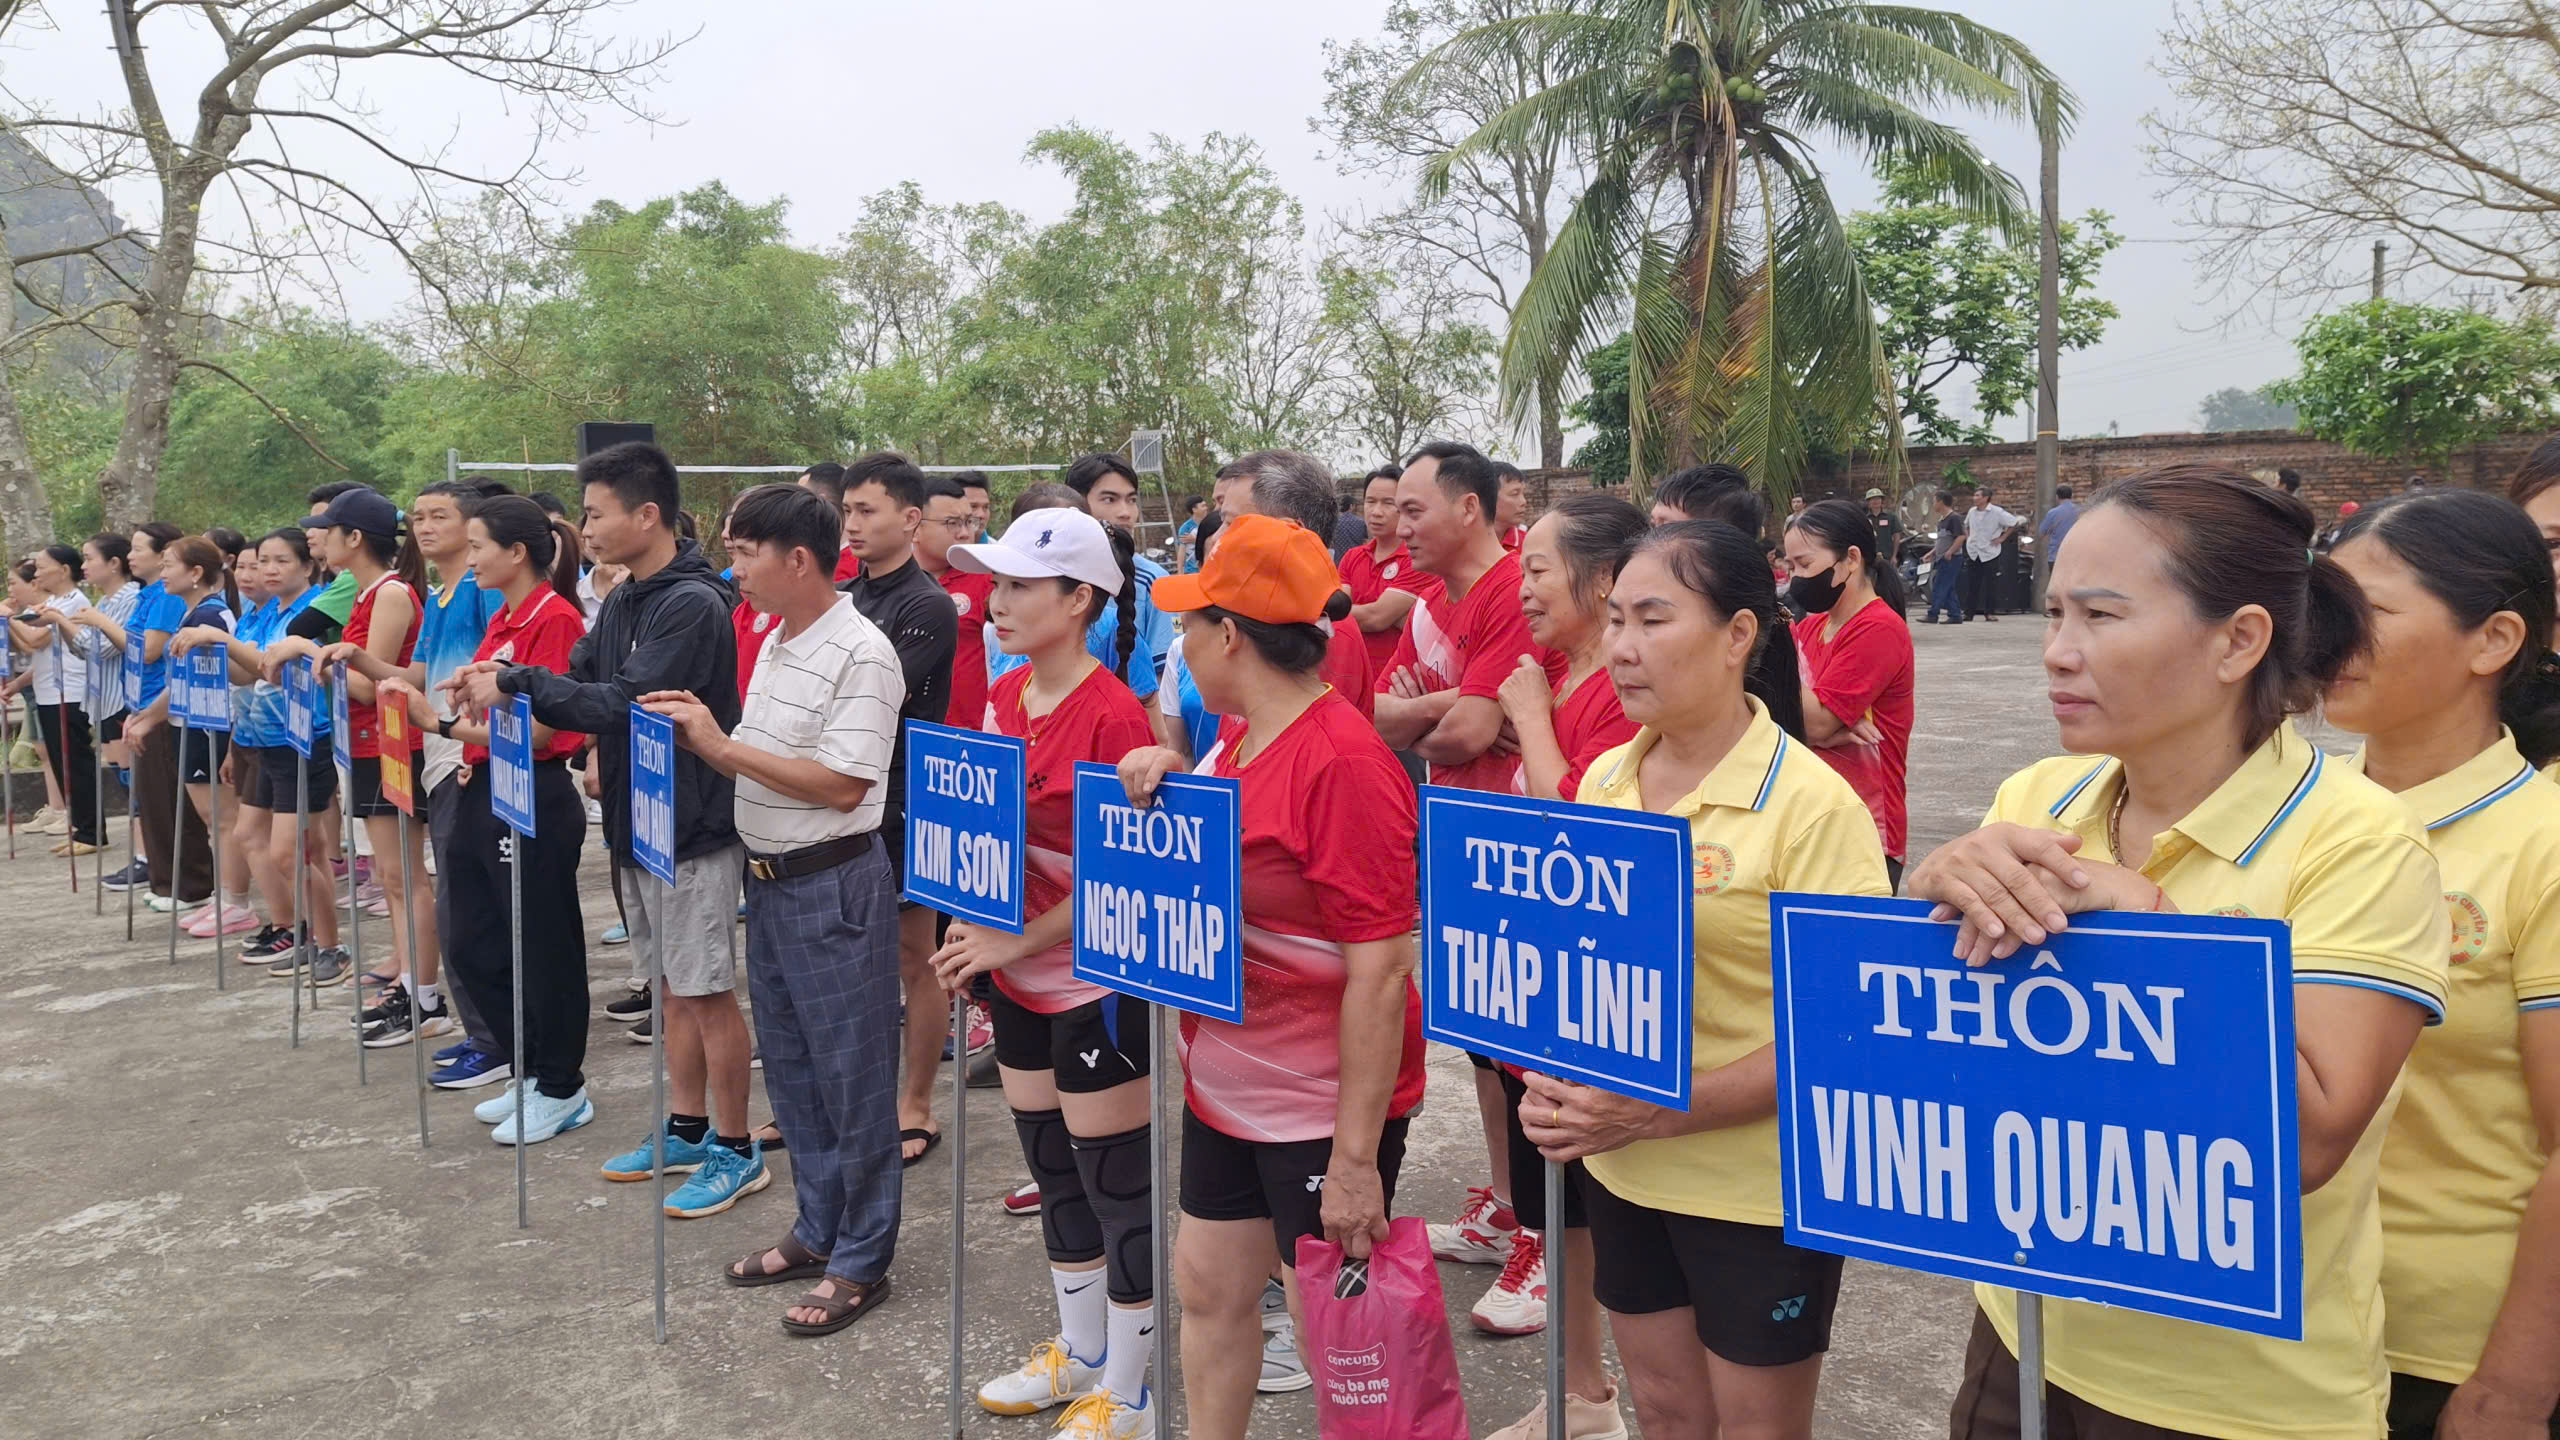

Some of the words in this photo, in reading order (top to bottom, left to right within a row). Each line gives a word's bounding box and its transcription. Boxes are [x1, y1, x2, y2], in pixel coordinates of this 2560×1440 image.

[514, 758, 528, 815] CÁT
[637, 728, 666, 776] THÔN
[924, 749, 998, 806] THÔN
[634, 787, 650, 845] CAO
[651, 790, 671, 866] HẬU
[914, 818, 951, 886] KIM
[957, 830, 1010, 903] SƠN
[1099, 796, 1203, 864] THÔN
[1465, 831, 1634, 916] THÔN
[1084, 880, 1147, 976] NGỌC
[1153, 885, 1224, 981] THÁP
[1443, 919, 1542, 1028] THÁP
[1558, 936, 1661, 1062] LĨNH
[1859, 950, 2185, 1066] THÔN
[1811, 1085, 1968, 1224] VINH
[1993, 1110, 2255, 1272] QUANG
[1332, 1393, 1359, 1405] nuôi
[1361, 1393, 1387, 1404] con
[1347, 1379, 1365, 1392] ba
[1368, 1378, 1390, 1391] mẹ
